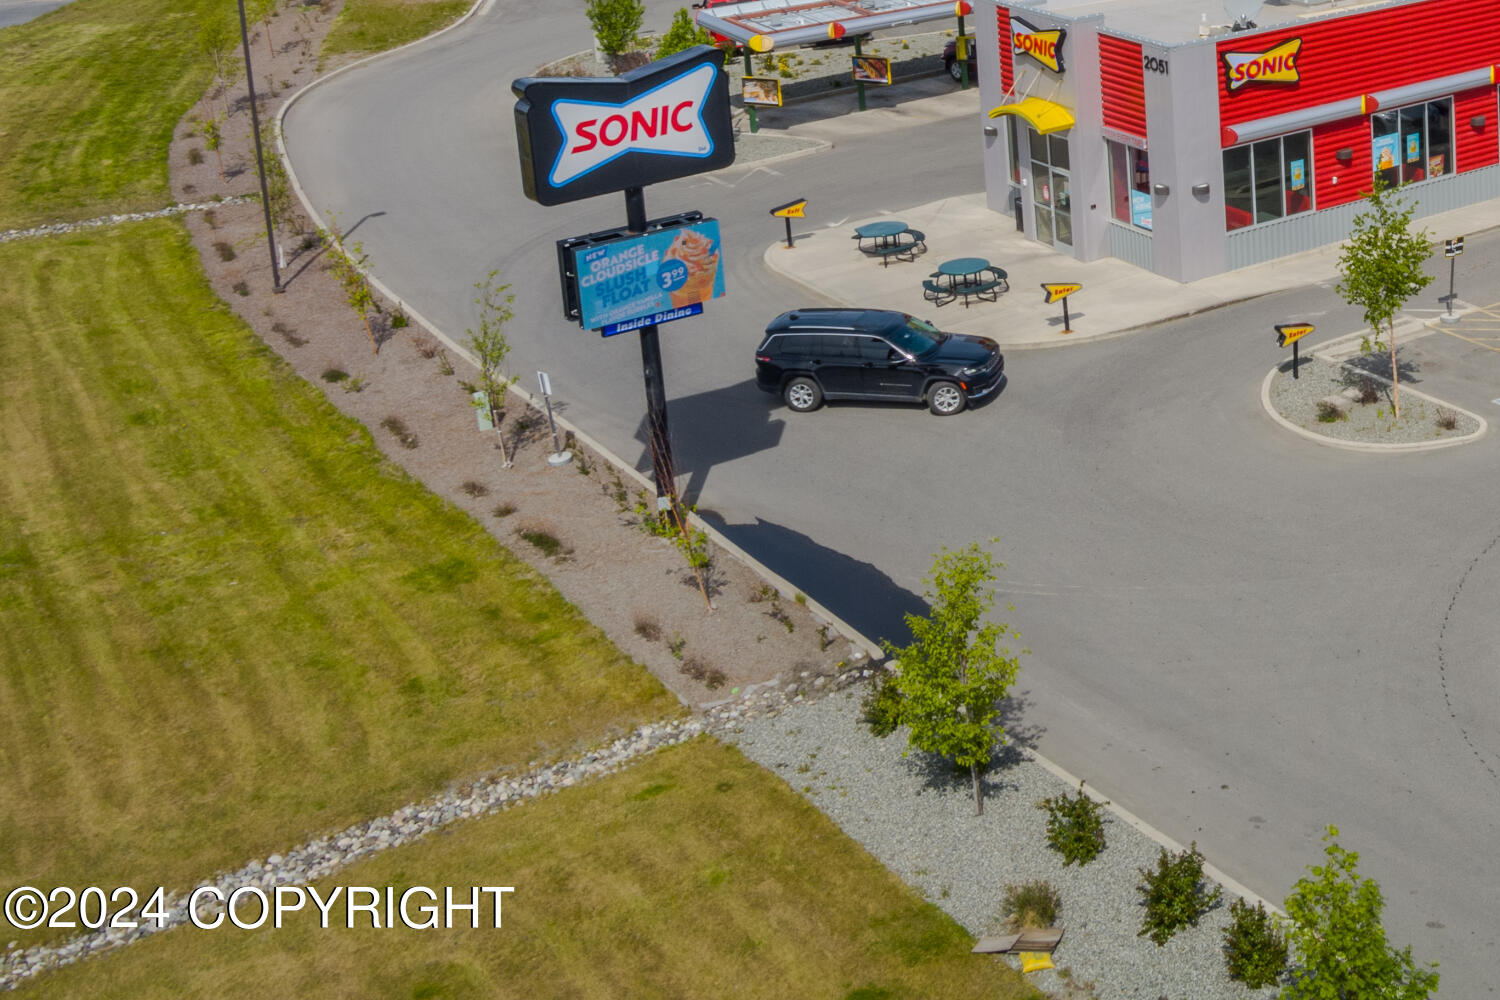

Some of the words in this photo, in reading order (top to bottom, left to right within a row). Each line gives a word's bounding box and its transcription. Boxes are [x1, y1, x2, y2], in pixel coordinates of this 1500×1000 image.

[1015, 33, 1056, 59] SONIC
[1144, 55, 1169, 76] 2051
[1233, 52, 1298, 82] SONIC
[571, 100, 694, 155] SONIC
[581, 250, 660, 287] CLOUDSICLE
[585, 249, 605, 262] NEW
[590, 244, 645, 272] ORANGE
[595, 266, 647, 297] SLUSH
[602, 278, 651, 308] FLOAT
[1054, 287, 1073, 295] Enter
[616, 315, 651, 333] Inside
[655, 306, 692, 322] Dining
